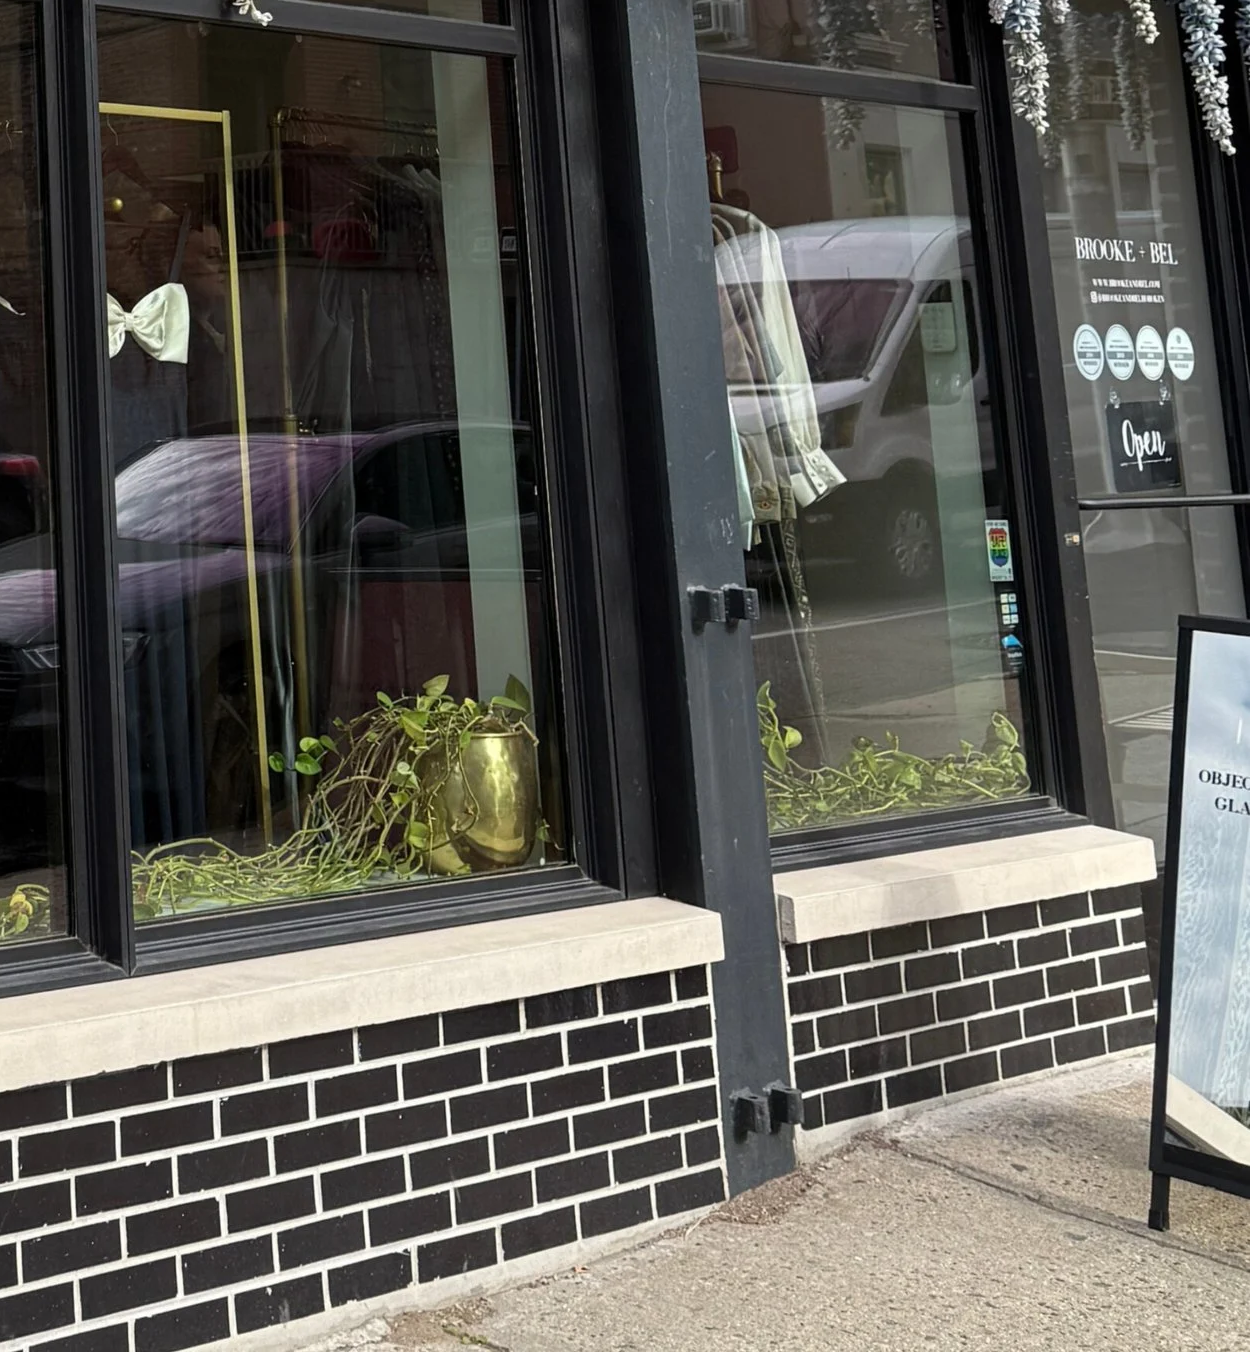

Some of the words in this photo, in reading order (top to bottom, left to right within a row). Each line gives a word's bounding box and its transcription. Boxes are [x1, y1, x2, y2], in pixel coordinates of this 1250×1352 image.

[1074, 236, 1136, 263] BROOKE
[1149, 241, 1179, 265] BEL
[1121, 419, 1166, 472] Open
